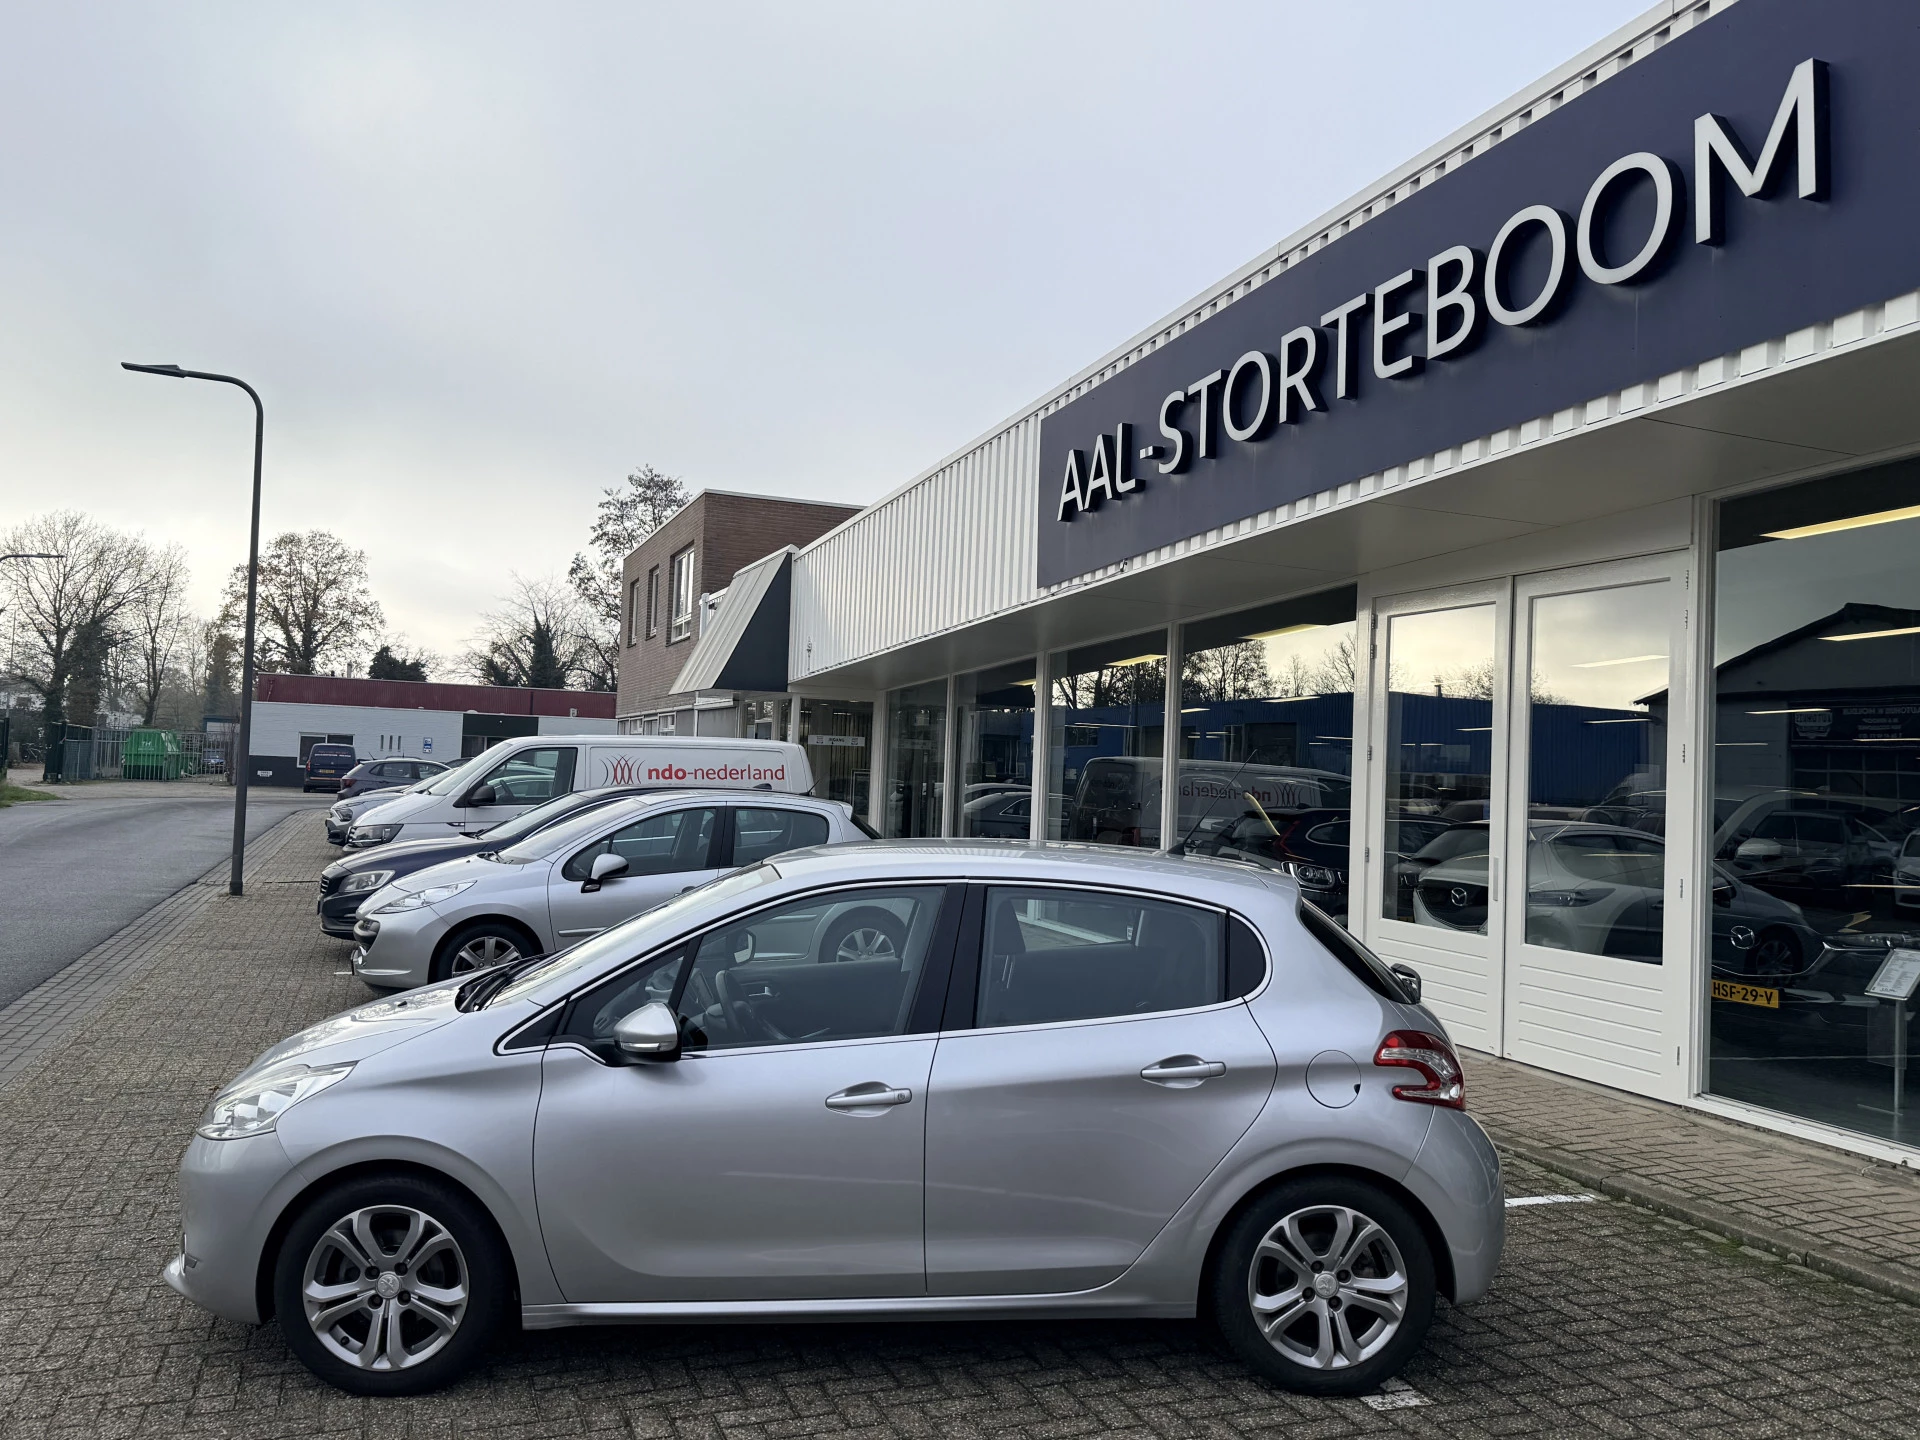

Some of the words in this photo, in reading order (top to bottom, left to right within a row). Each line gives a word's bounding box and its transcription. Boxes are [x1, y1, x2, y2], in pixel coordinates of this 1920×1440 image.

[1057, 58, 1828, 521] AAL-STORTEBOOM
[647, 763, 785, 780] ndo-nederland
[1713, 981, 1773, 1005] HSF-29-V
